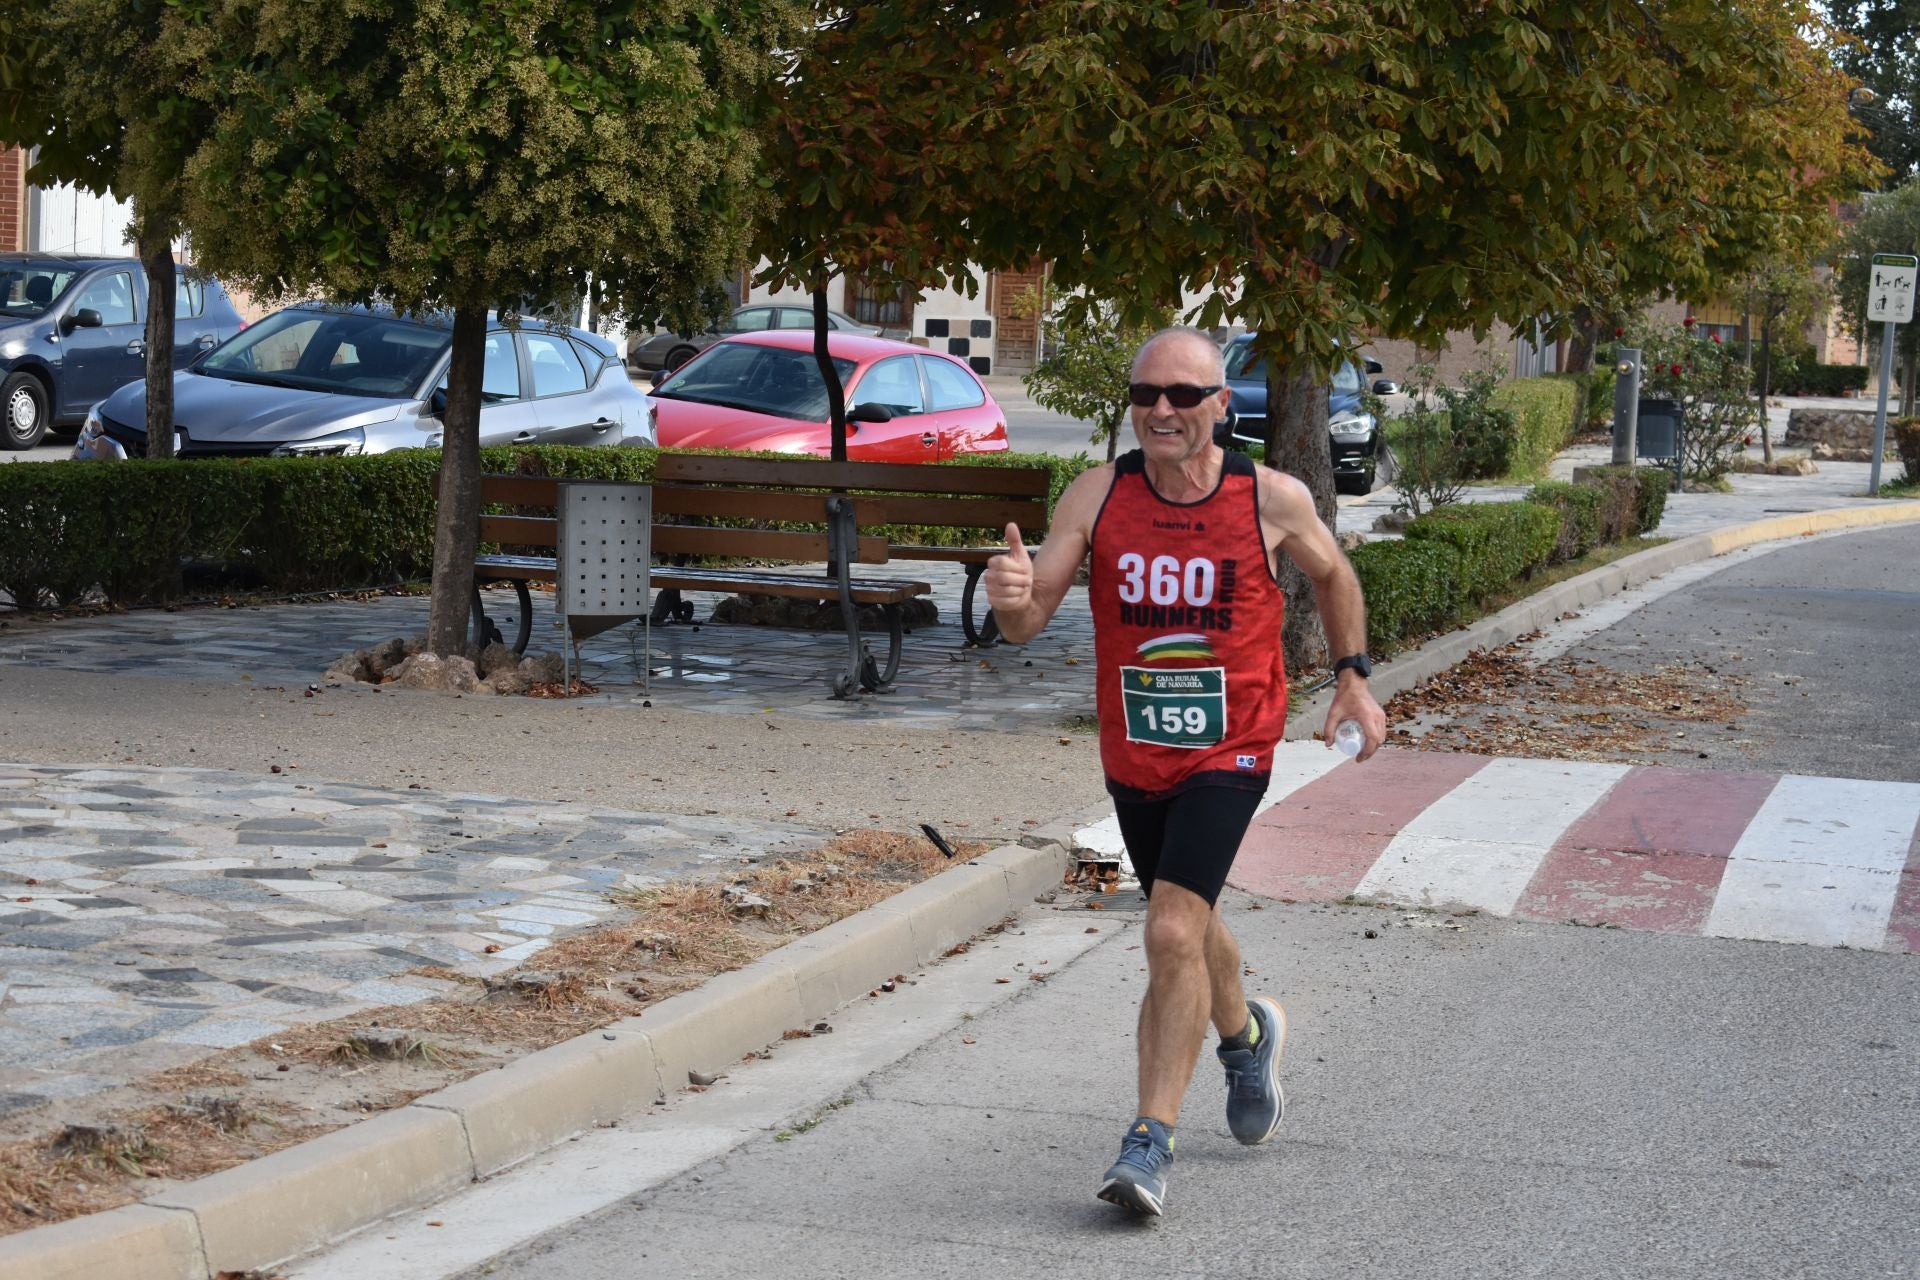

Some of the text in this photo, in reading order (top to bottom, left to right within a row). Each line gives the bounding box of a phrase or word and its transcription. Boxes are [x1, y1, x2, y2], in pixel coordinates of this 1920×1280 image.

[1117, 552, 1215, 607] 360
[1120, 602, 1233, 630] RUNNERS
[1155, 674, 1200, 682] CAJA RURAL
[1141, 704, 1207, 734] 159
